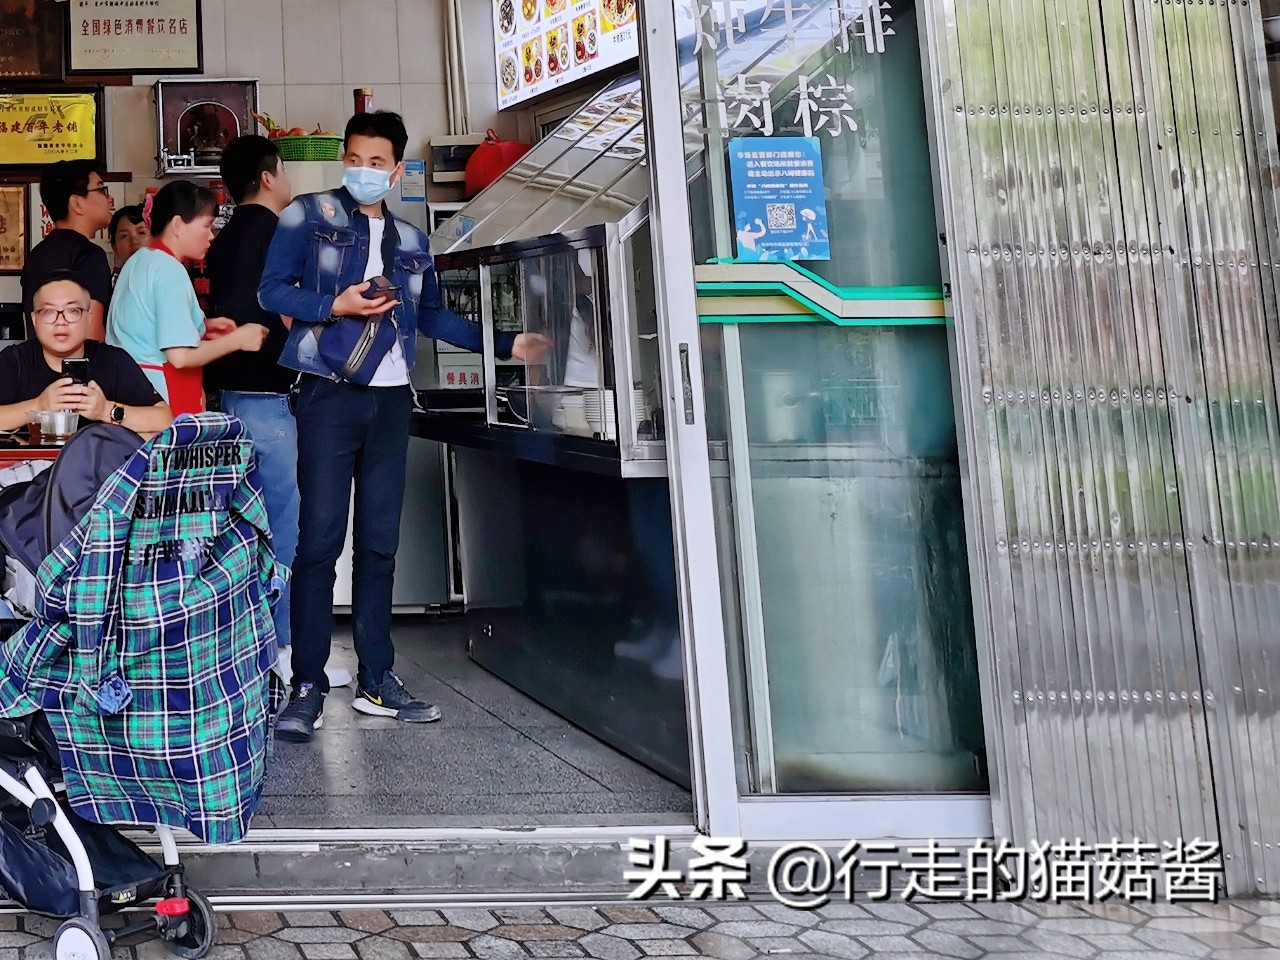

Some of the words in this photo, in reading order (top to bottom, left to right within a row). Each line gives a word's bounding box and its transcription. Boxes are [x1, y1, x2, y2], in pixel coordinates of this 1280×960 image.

[81, 18, 188, 36] 全国绿色消费餐饮名店
[716, 73, 858, 137] 肉粽
[174, 438, 242, 470] WHISPER
